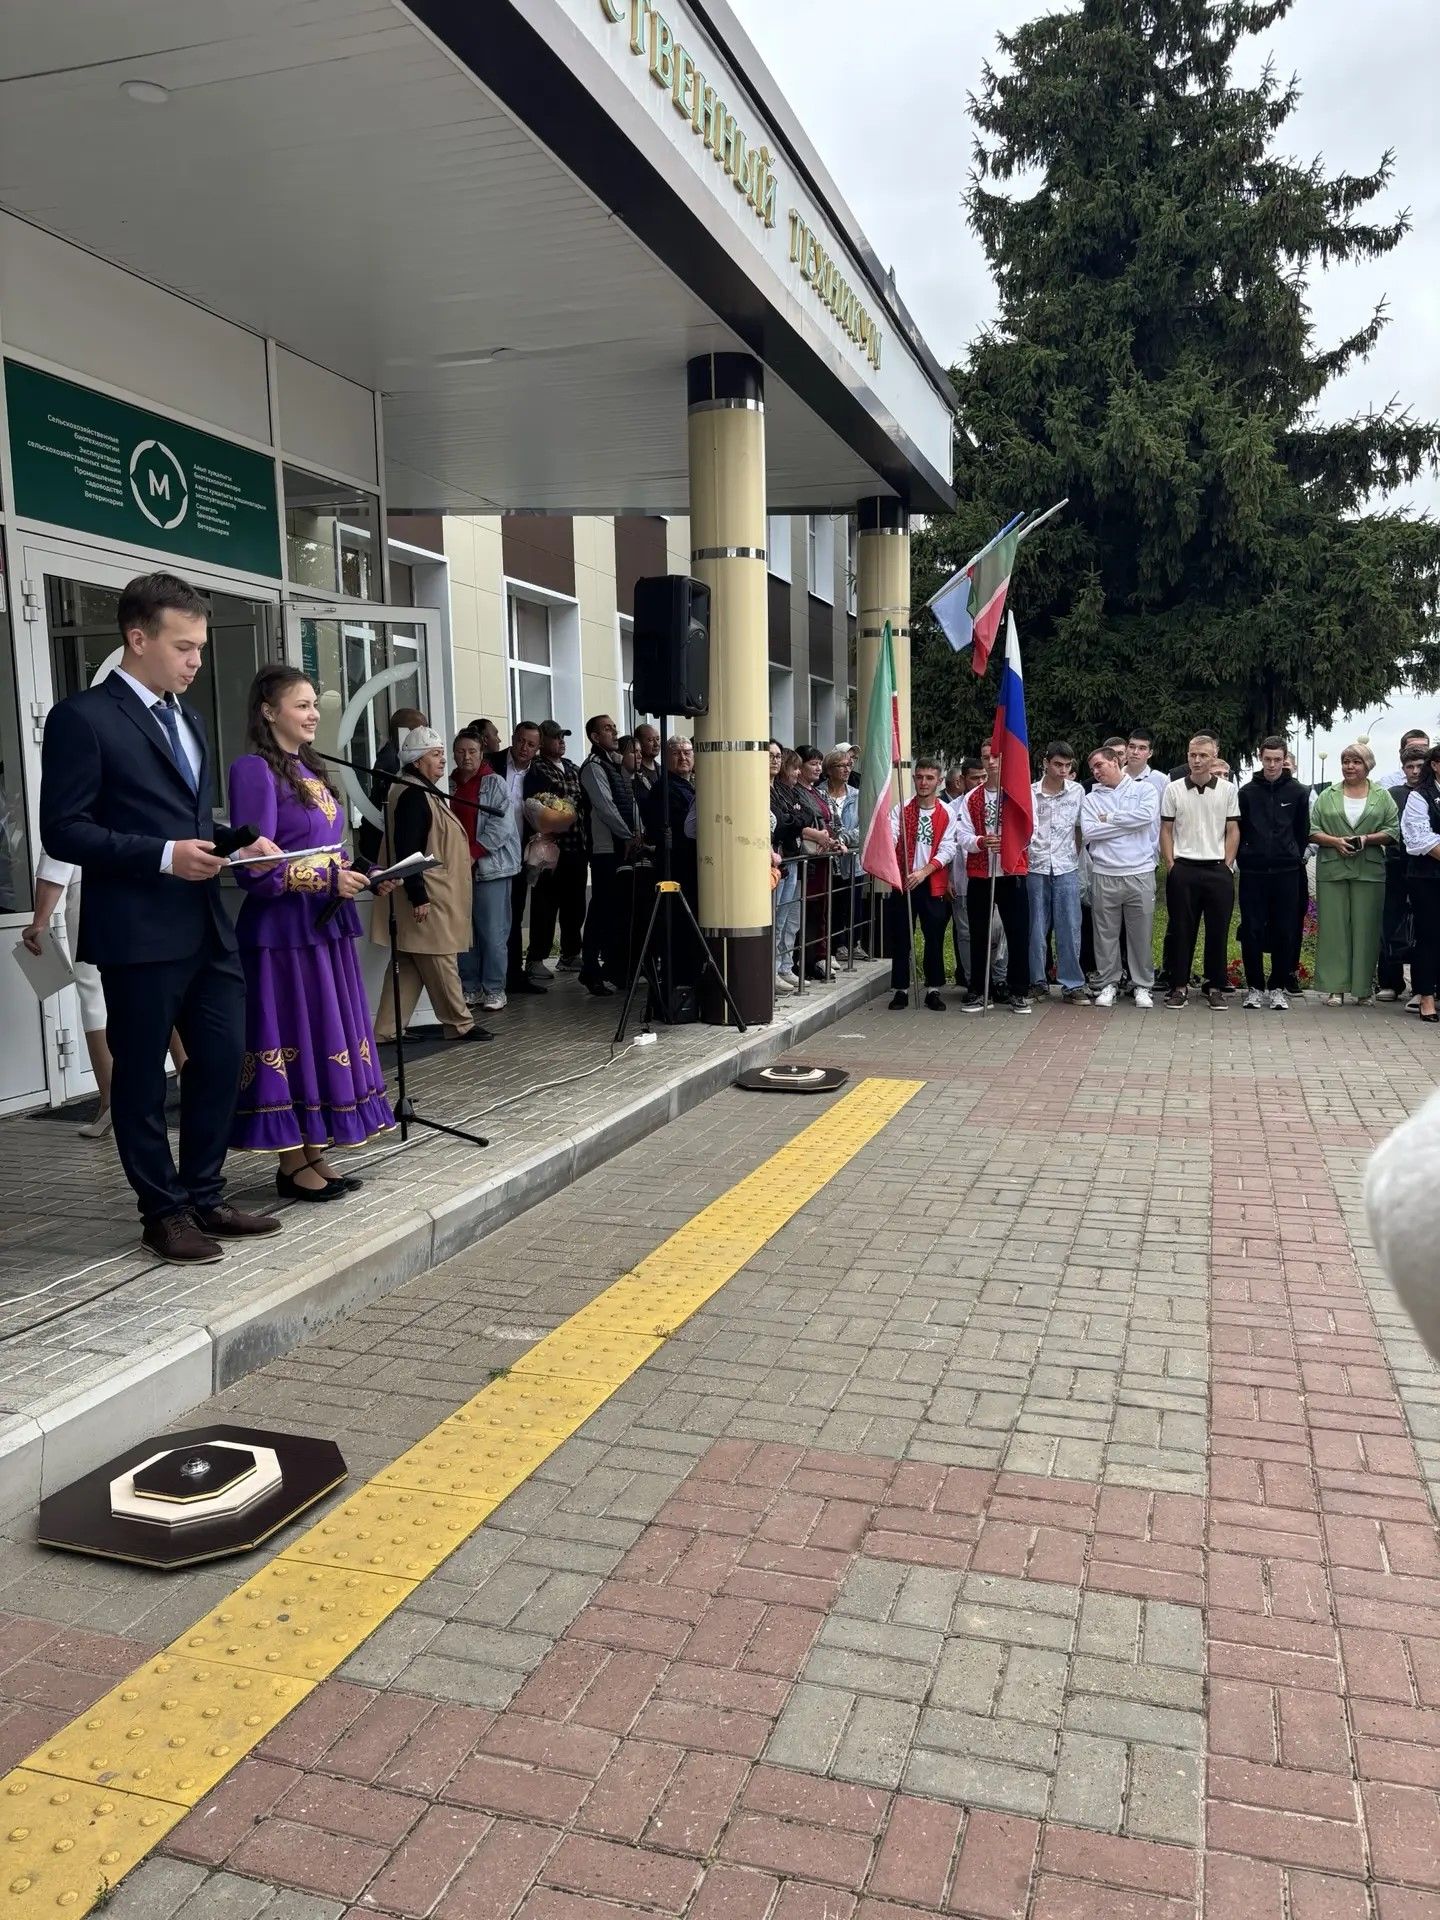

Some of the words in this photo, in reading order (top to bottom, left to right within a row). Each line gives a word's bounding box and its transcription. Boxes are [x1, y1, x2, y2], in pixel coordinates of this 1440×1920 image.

[602, 0, 776, 228] ТВЕННЫЙ
[74, 432, 120, 453] биотехнологии
[79, 445, 121, 465] Эксплуатация
[74, 465, 122, 486] Промышленное
[85, 479, 123, 495] садоводство
[84, 490, 123, 507] Ветеринария
